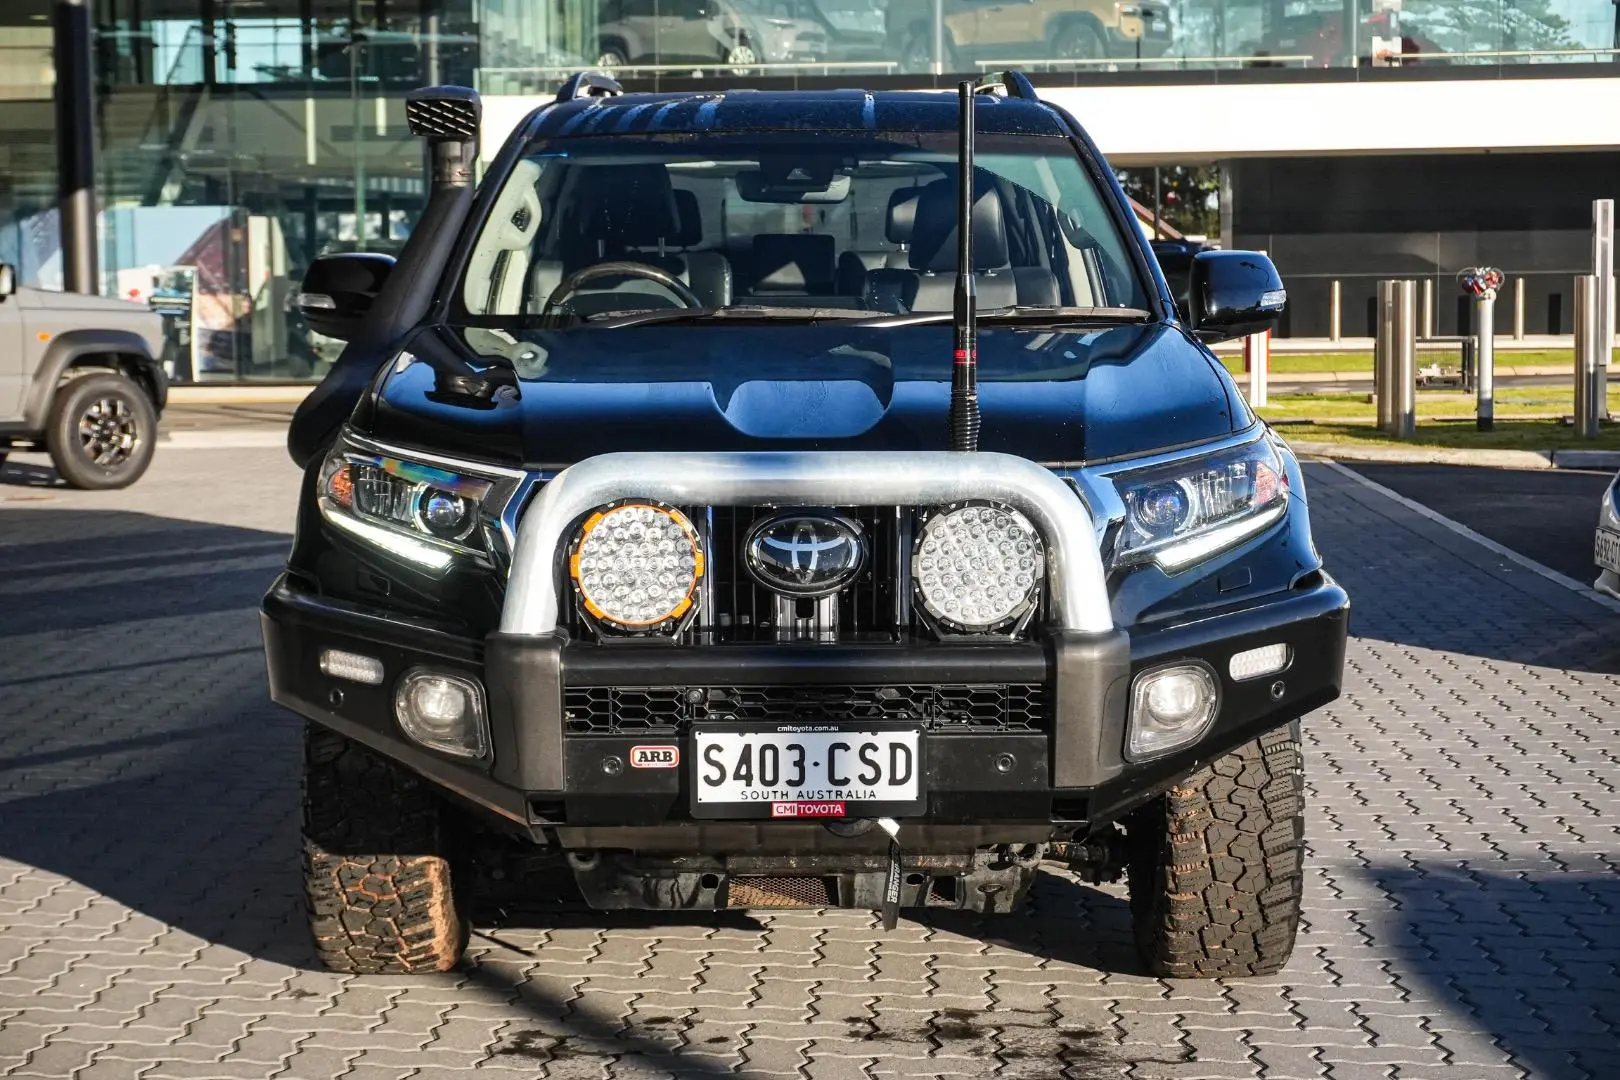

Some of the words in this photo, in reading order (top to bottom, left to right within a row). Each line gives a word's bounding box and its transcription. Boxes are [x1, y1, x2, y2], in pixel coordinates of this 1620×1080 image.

[777, 724, 839, 732] cmitoyota.com.au
[638, 751, 673, 762] ARB
[741, 790, 789, 800] SOUTH
[797, 790, 877, 800] AUSTRALIA
[798, 804, 843, 814] TOYOTA
